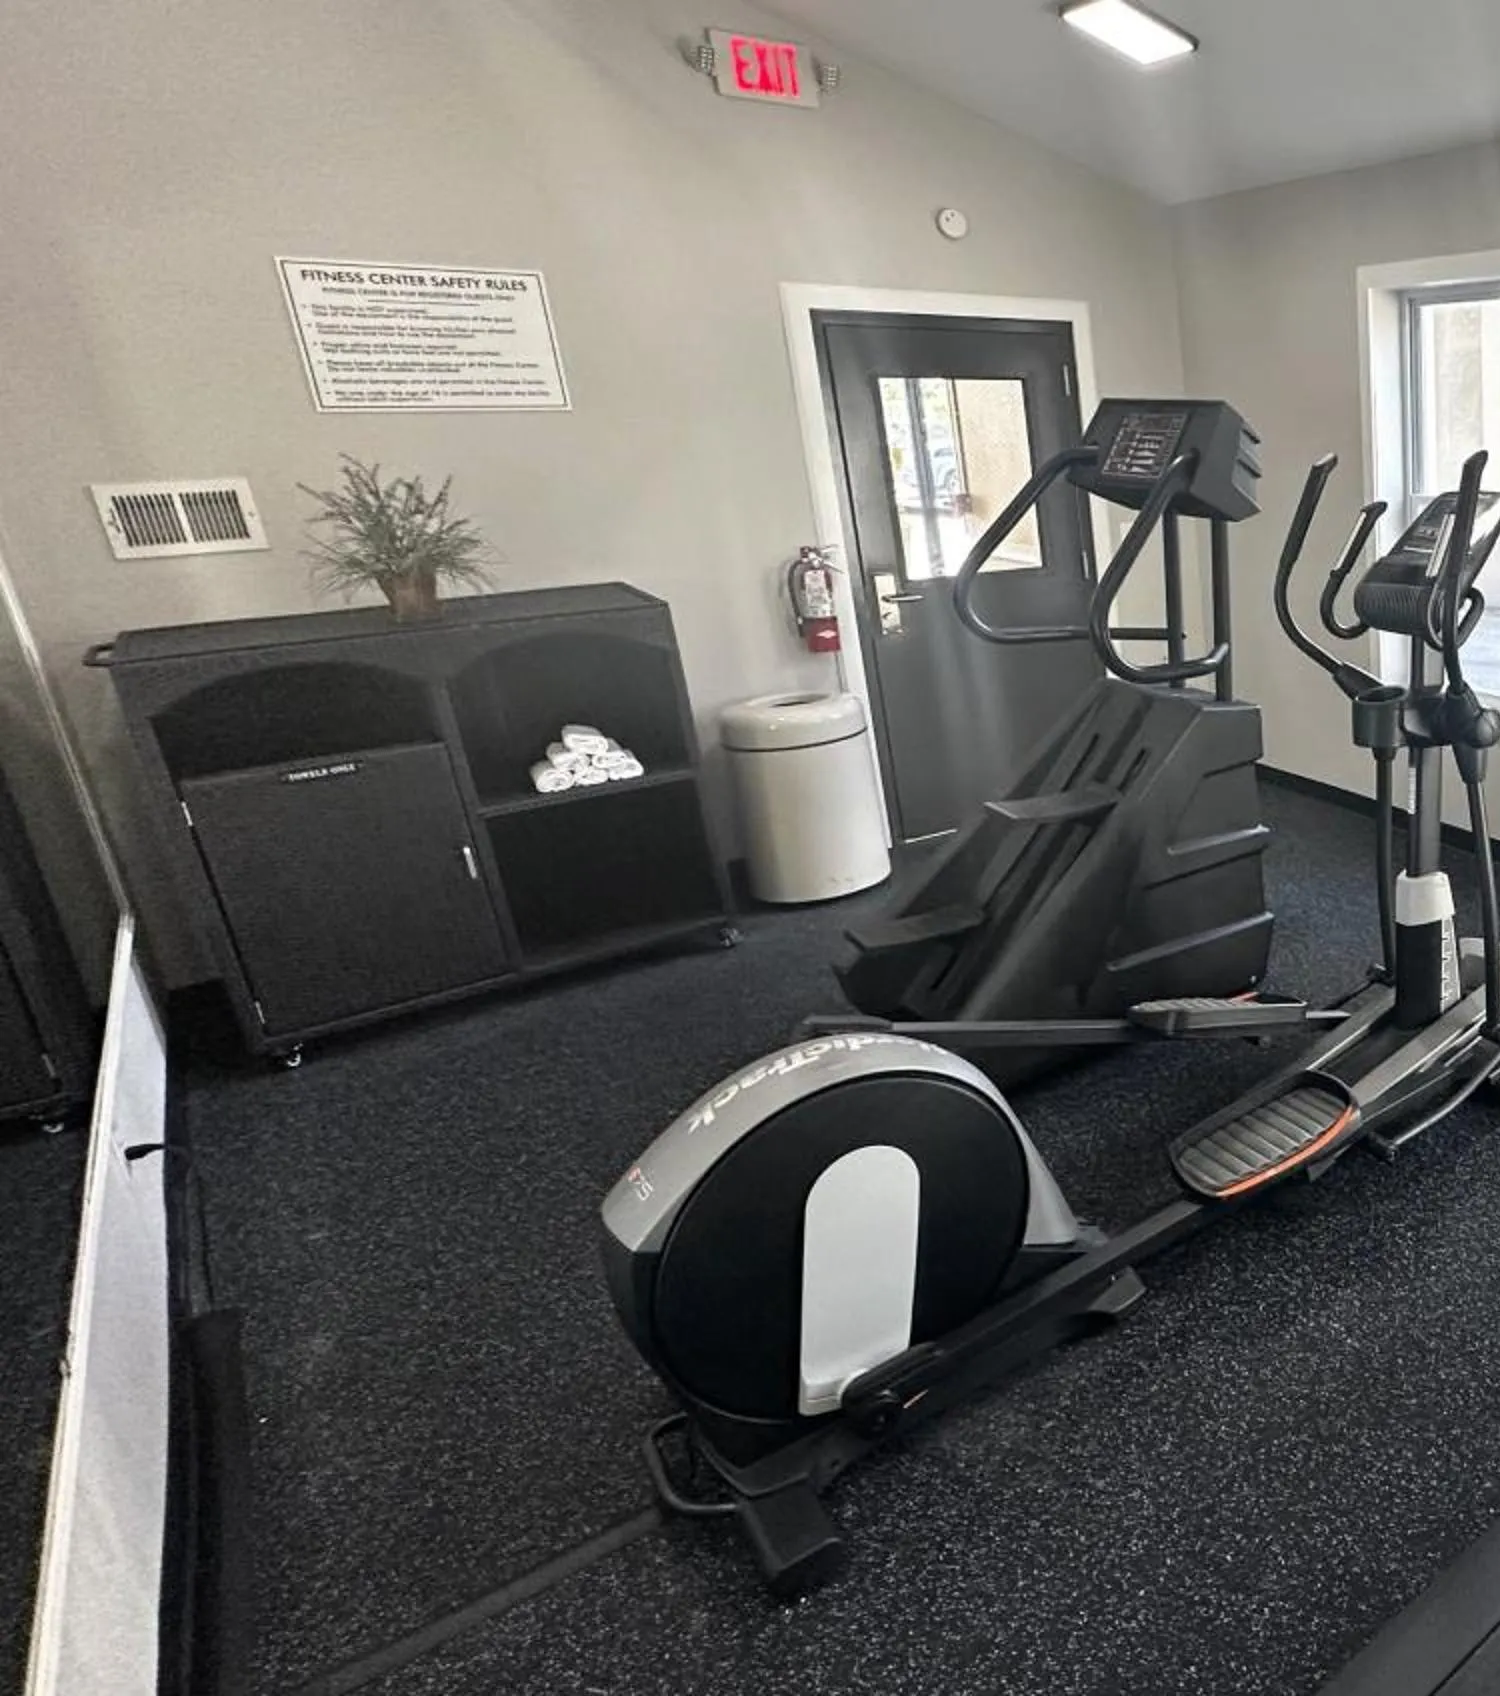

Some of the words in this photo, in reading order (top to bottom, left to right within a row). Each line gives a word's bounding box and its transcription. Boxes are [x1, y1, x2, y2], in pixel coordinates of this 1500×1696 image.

[730, 35, 801, 97] EXIT
[300, 269, 364, 284] FITNESS
[368, 273, 426, 287] CENTER
[430, 276, 480, 290] SAFETY
[485, 279, 527, 293] RULES
